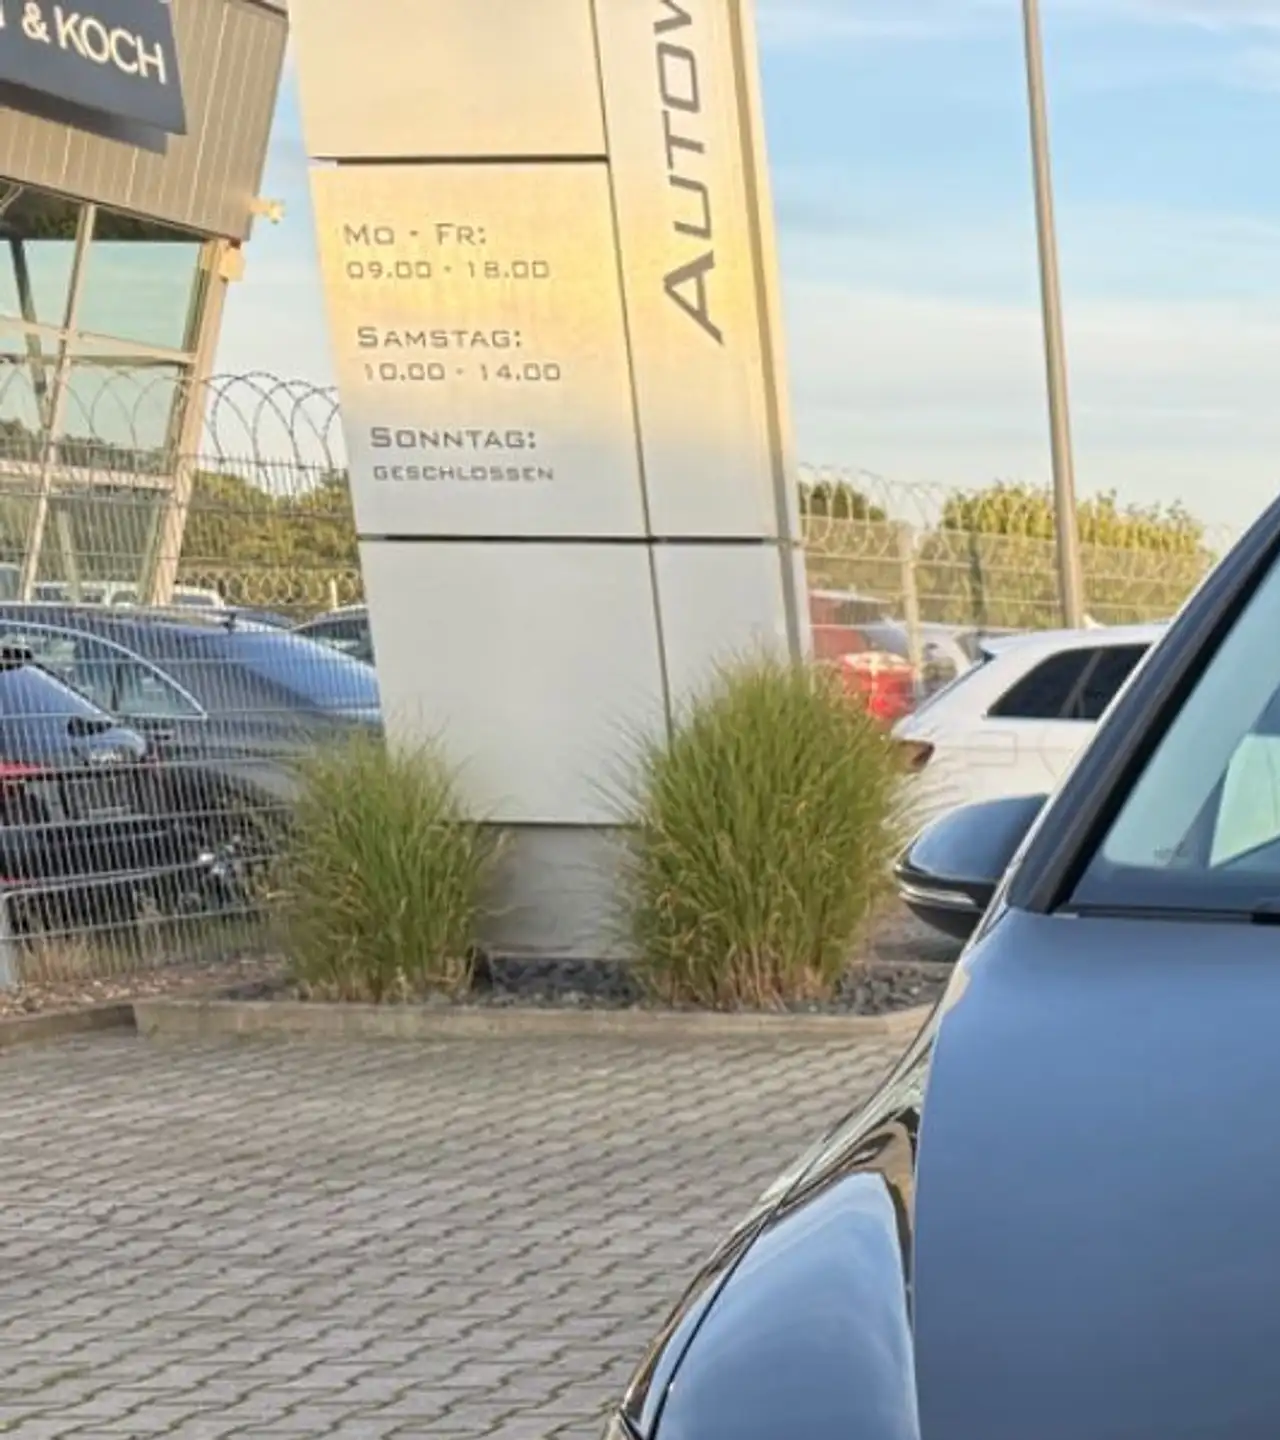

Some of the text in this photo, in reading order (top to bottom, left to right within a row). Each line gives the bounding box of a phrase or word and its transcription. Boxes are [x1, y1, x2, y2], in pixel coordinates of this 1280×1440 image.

[22, 1, 51, 44] &
[53, 5, 167, 85] KOCH
[346, 260, 431, 279] 09.00
[468, 260, 550, 279] 18.00
[357, 325, 522, 349] SAMSTAG:
[364, 362, 446, 381] 10.00
[480, 362, 561, 381] 14.00
[370, 427, 537, 450] SONNTAG:
[373, 464, 554, 482] GESCHLOSSEN
